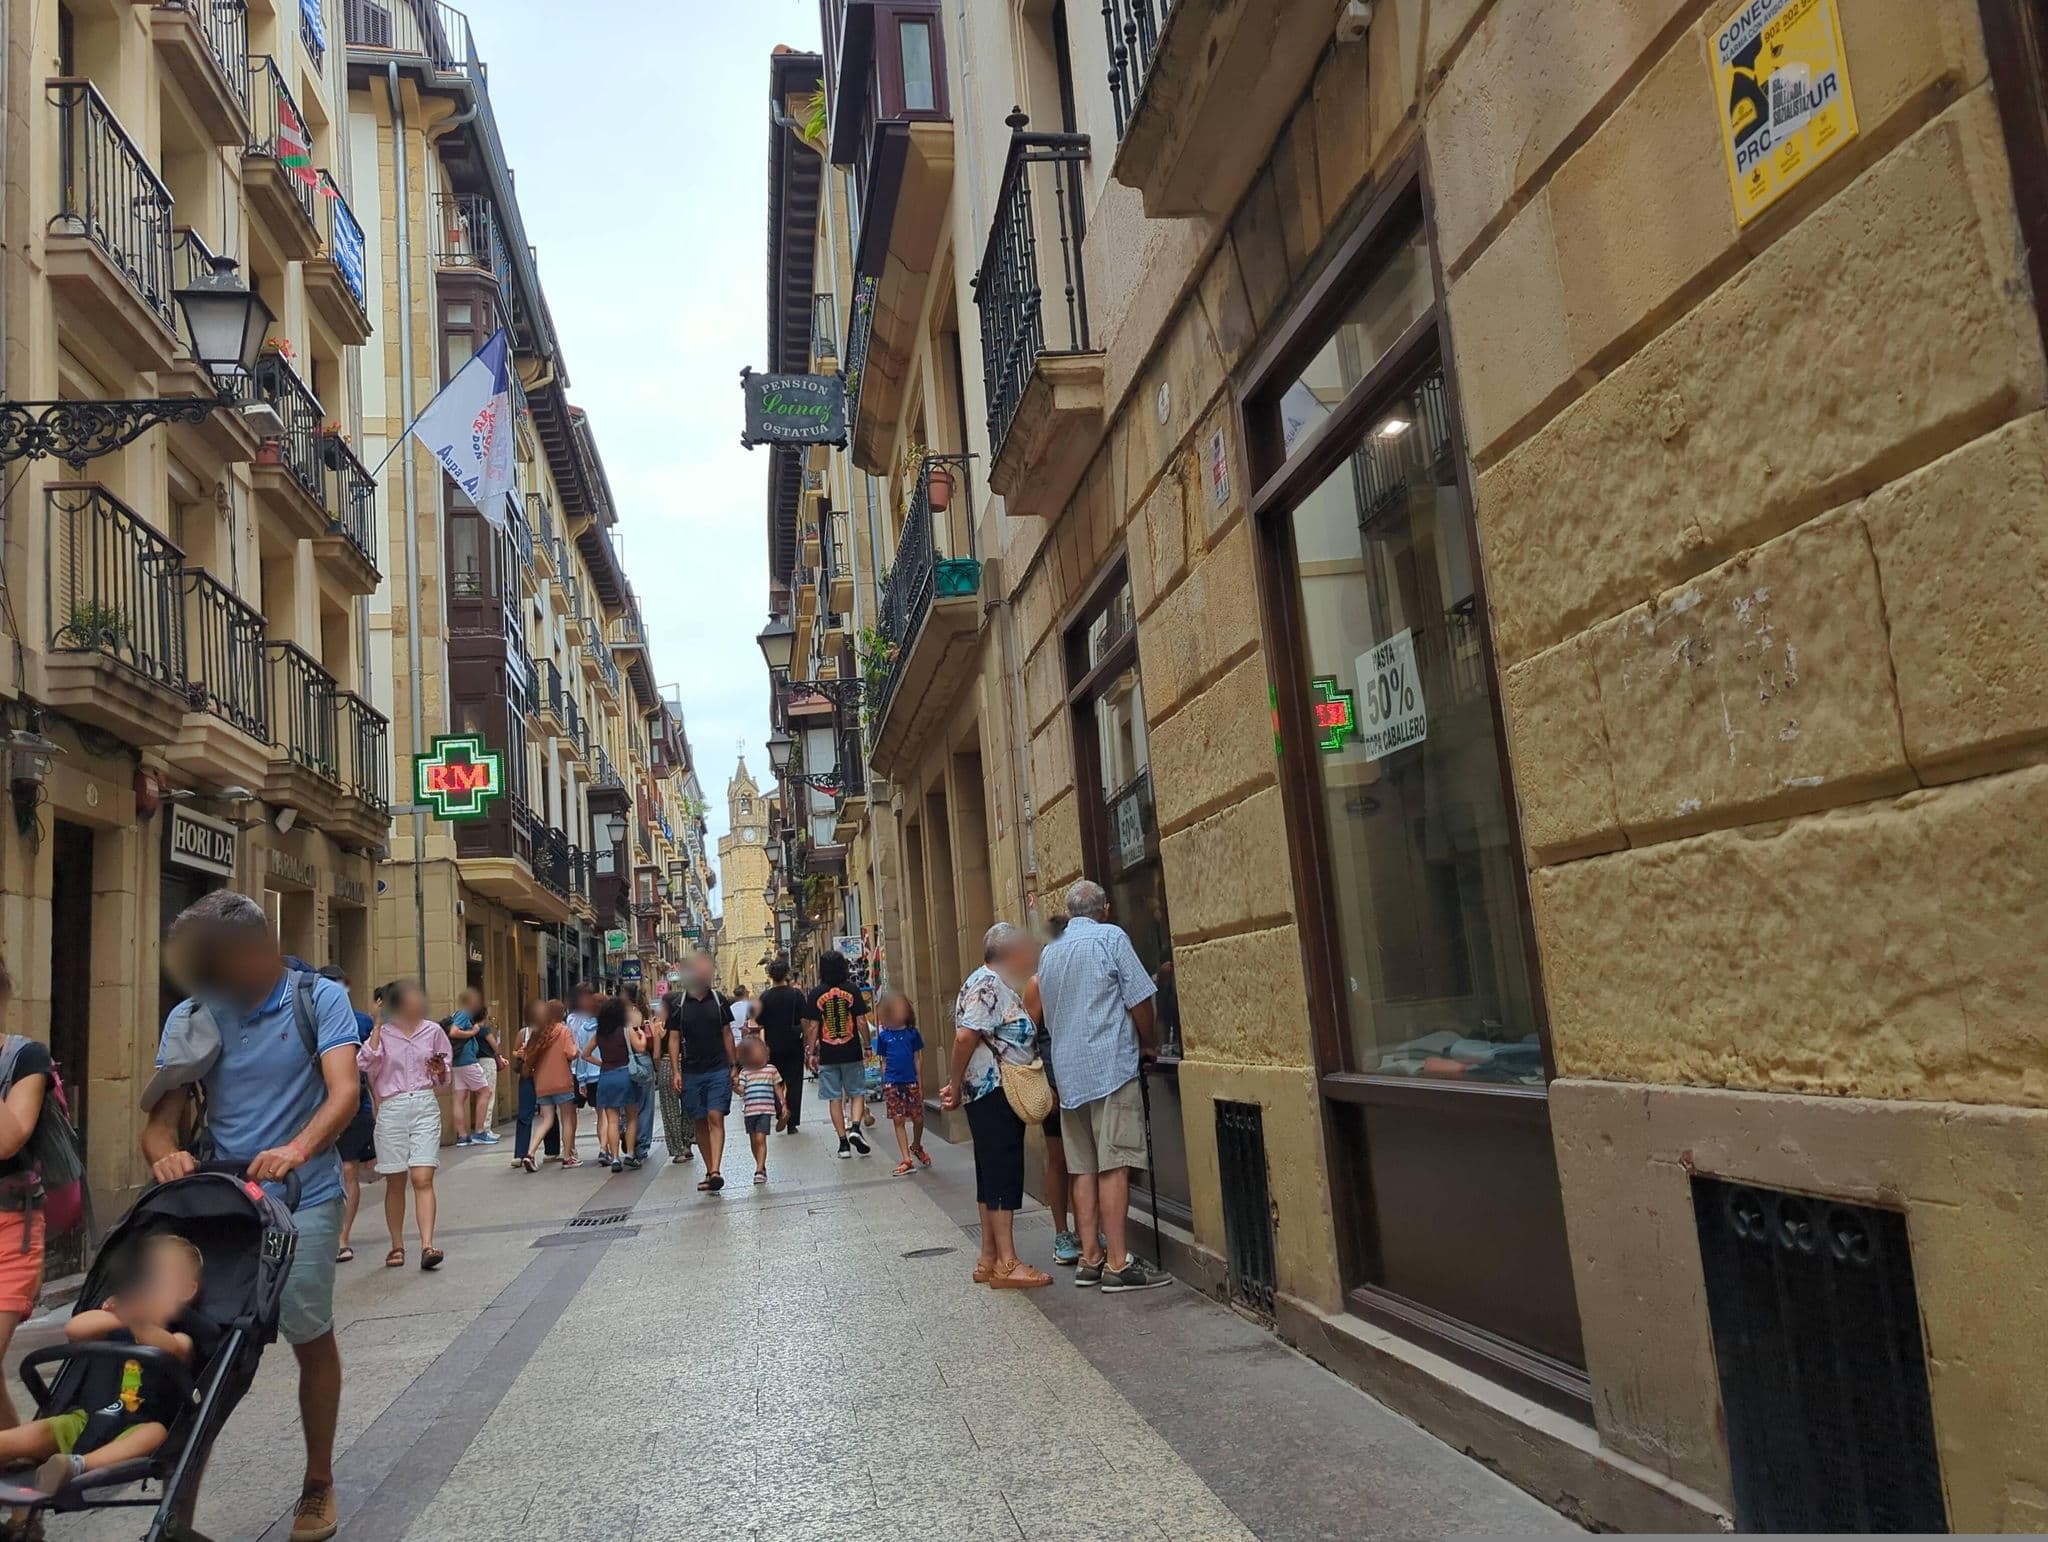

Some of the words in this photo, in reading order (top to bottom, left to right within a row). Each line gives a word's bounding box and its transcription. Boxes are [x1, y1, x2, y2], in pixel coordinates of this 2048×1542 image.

[1748, 19, 1763, 38] CON
[1764, 22, 1780, 43] 902
[1782, 4, 1799, 26] 202
[1736, 72, 1837, 173] PROUR
[762, 379, 829, 395] PENSION
[760, 392, 832, 426] Loinaz
[762, 422, 830, 438] OSTATUA
[436, 444, 463, 479] Aupa
[1367, 663, 1415, 726] 50%
[1383, 714, 1426, 751] CABALLERO
[427, 763, 489, 792] RM
[175, 818, 211, 858] HORI
[214, 833, 233, 865] DA
